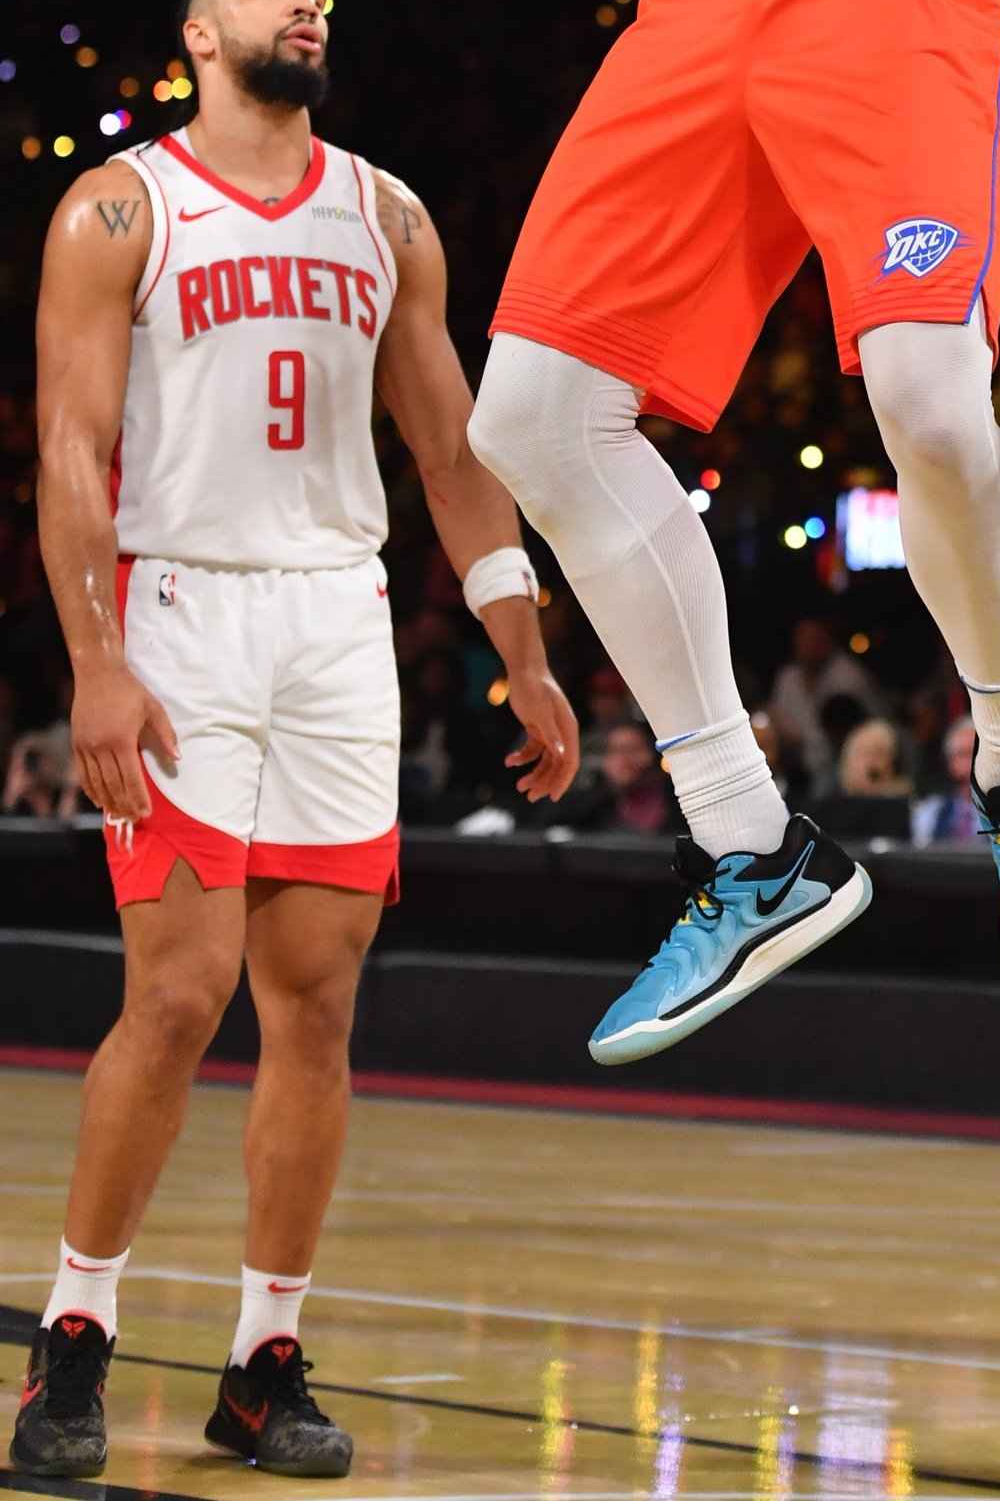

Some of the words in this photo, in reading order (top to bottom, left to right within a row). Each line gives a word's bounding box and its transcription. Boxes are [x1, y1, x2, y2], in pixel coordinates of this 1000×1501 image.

[97, 200, 141, 238] W
[401, 208, 422, 244] P
[884, 230, 942, 269] OKC
[177, 255, 378, 342] ROCKETS
[268, 350, 305, 450] 9
